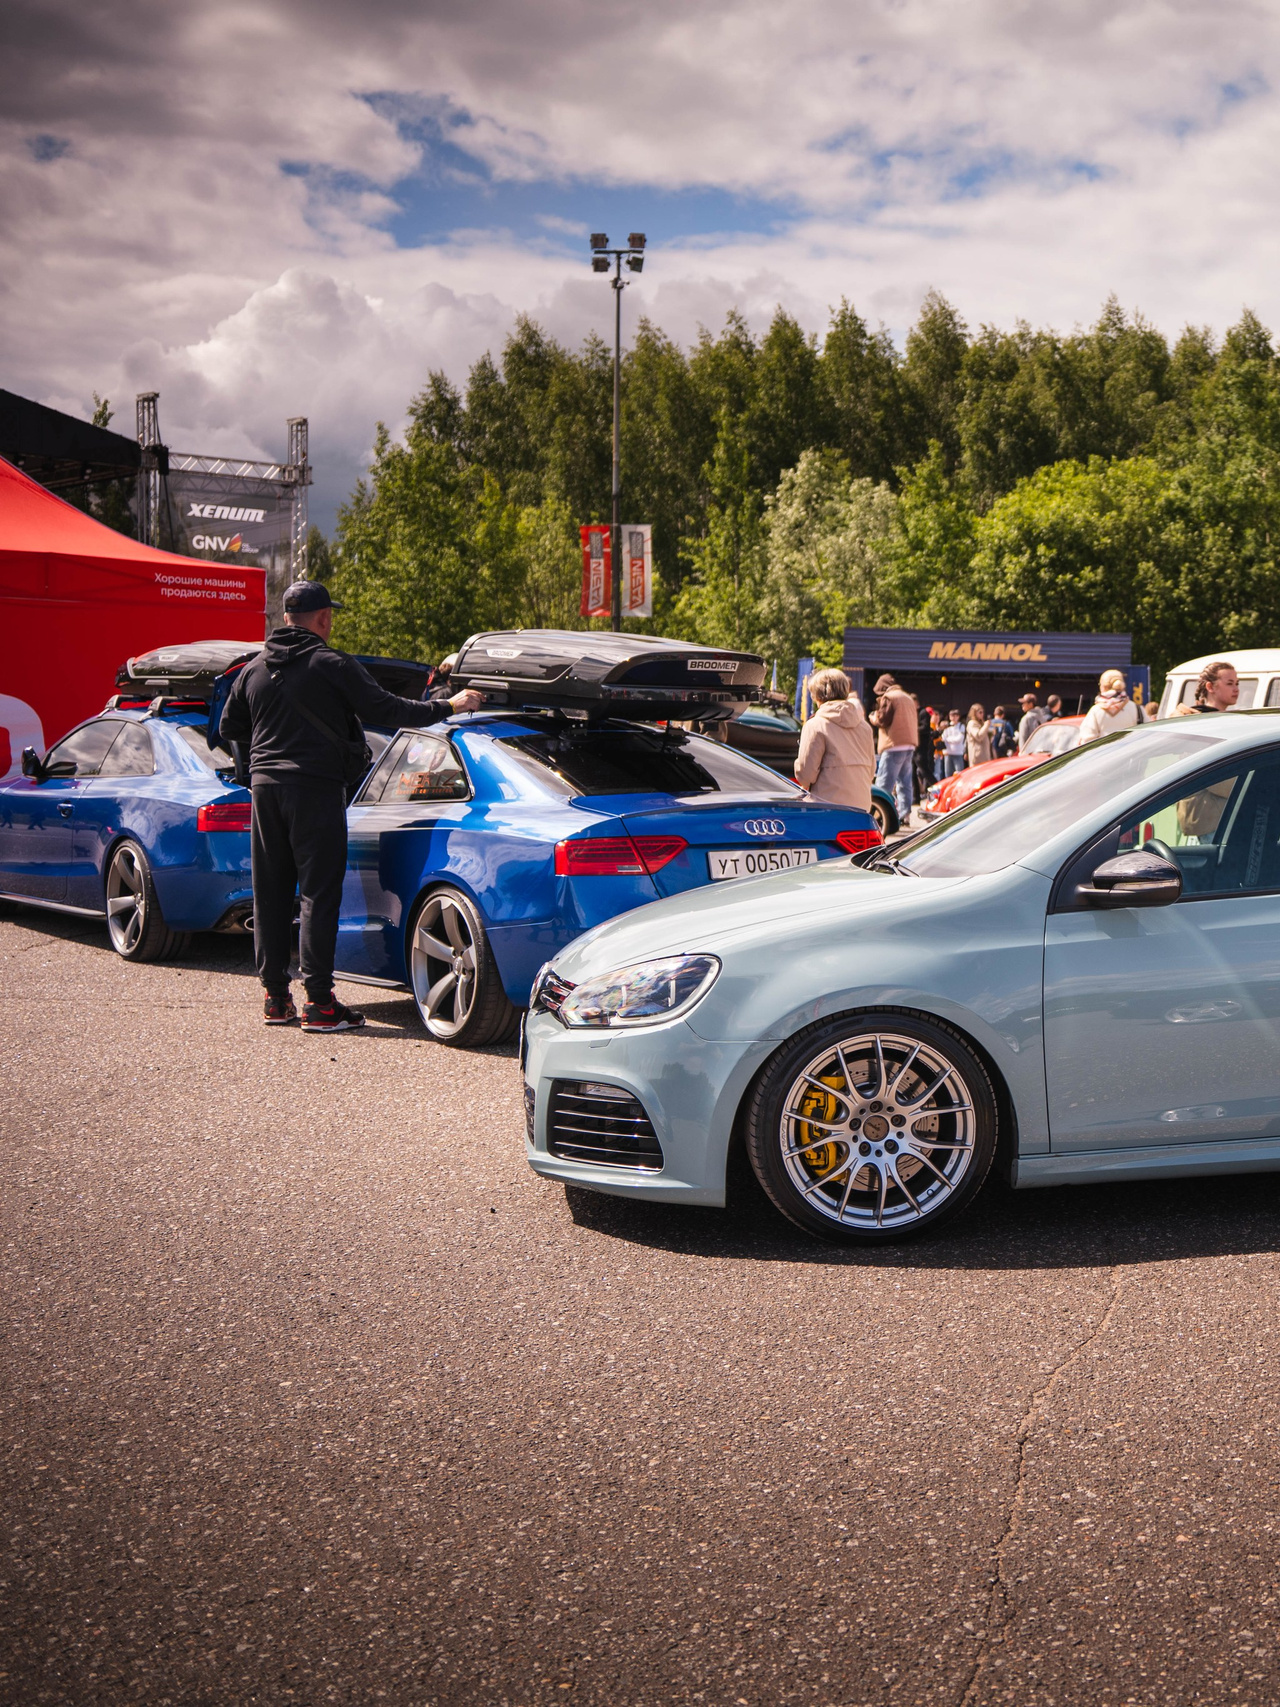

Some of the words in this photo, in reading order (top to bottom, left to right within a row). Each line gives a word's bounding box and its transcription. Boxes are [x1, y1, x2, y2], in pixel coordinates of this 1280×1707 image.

[187, 503, 264, 523] XENUM
[192, 535, 230, 551] GNV
[155, 573, 202, 585] Хорошие
[204, 578, 246, 588] машины
[591, 561, 602, 607] VASIN
[631, 560, 643, 607] VASIN
[161, 587, 216, 599] продаются
[218, 592, 246, 600] здесь
[928, 641, 1047, 662] MANNOL
[690, 661, 737, 670] BROOMER
[745, 853, 790, 873] 0050
[793, 851, 810, 866] 77
